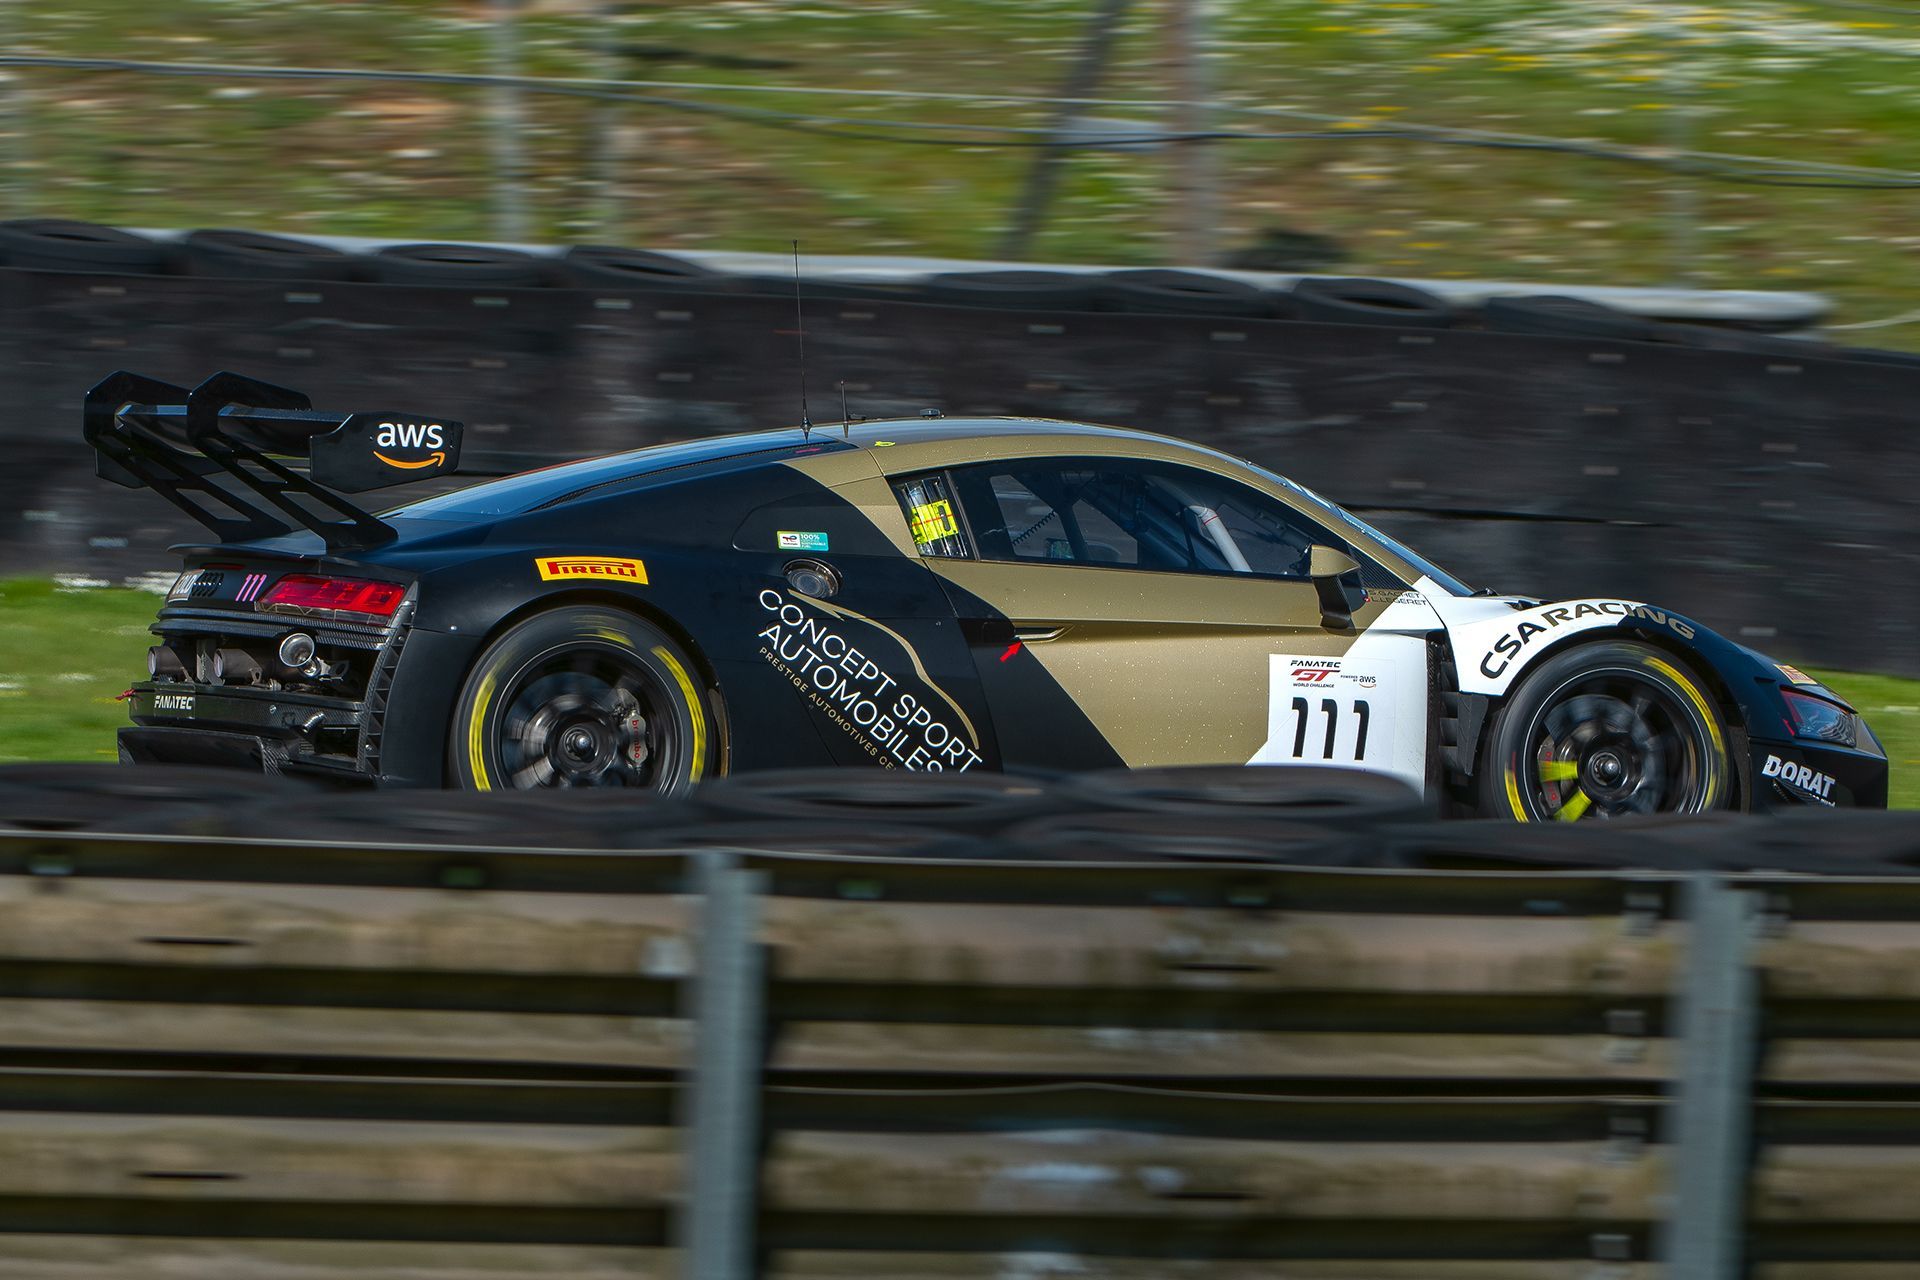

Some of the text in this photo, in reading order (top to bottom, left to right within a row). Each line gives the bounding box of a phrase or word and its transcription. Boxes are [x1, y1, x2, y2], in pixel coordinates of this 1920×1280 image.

[377, 423, 443, 449] aws
[547, 561, 637, 577] PIRELLI
[235, 574, 268, 602] 111
[1479, 602, 1696, 679] CSA RACING
[1290, 660, 1342, 669] FANATEC
[1290, 669, 1341, 682] GT
[759, 589, 983, 774] CONCEPT SPORT
[1359, 675, 1377, 684] aws
[154, 695, 194, 710] FANATEC
[759, 646, 809, 693] PRESTIGE
[808, 692, 878, 756] AUTOMOTIVES
[1291, 696, 1370, 761] 111
[1762, 754, 1836, 798] DORAT
